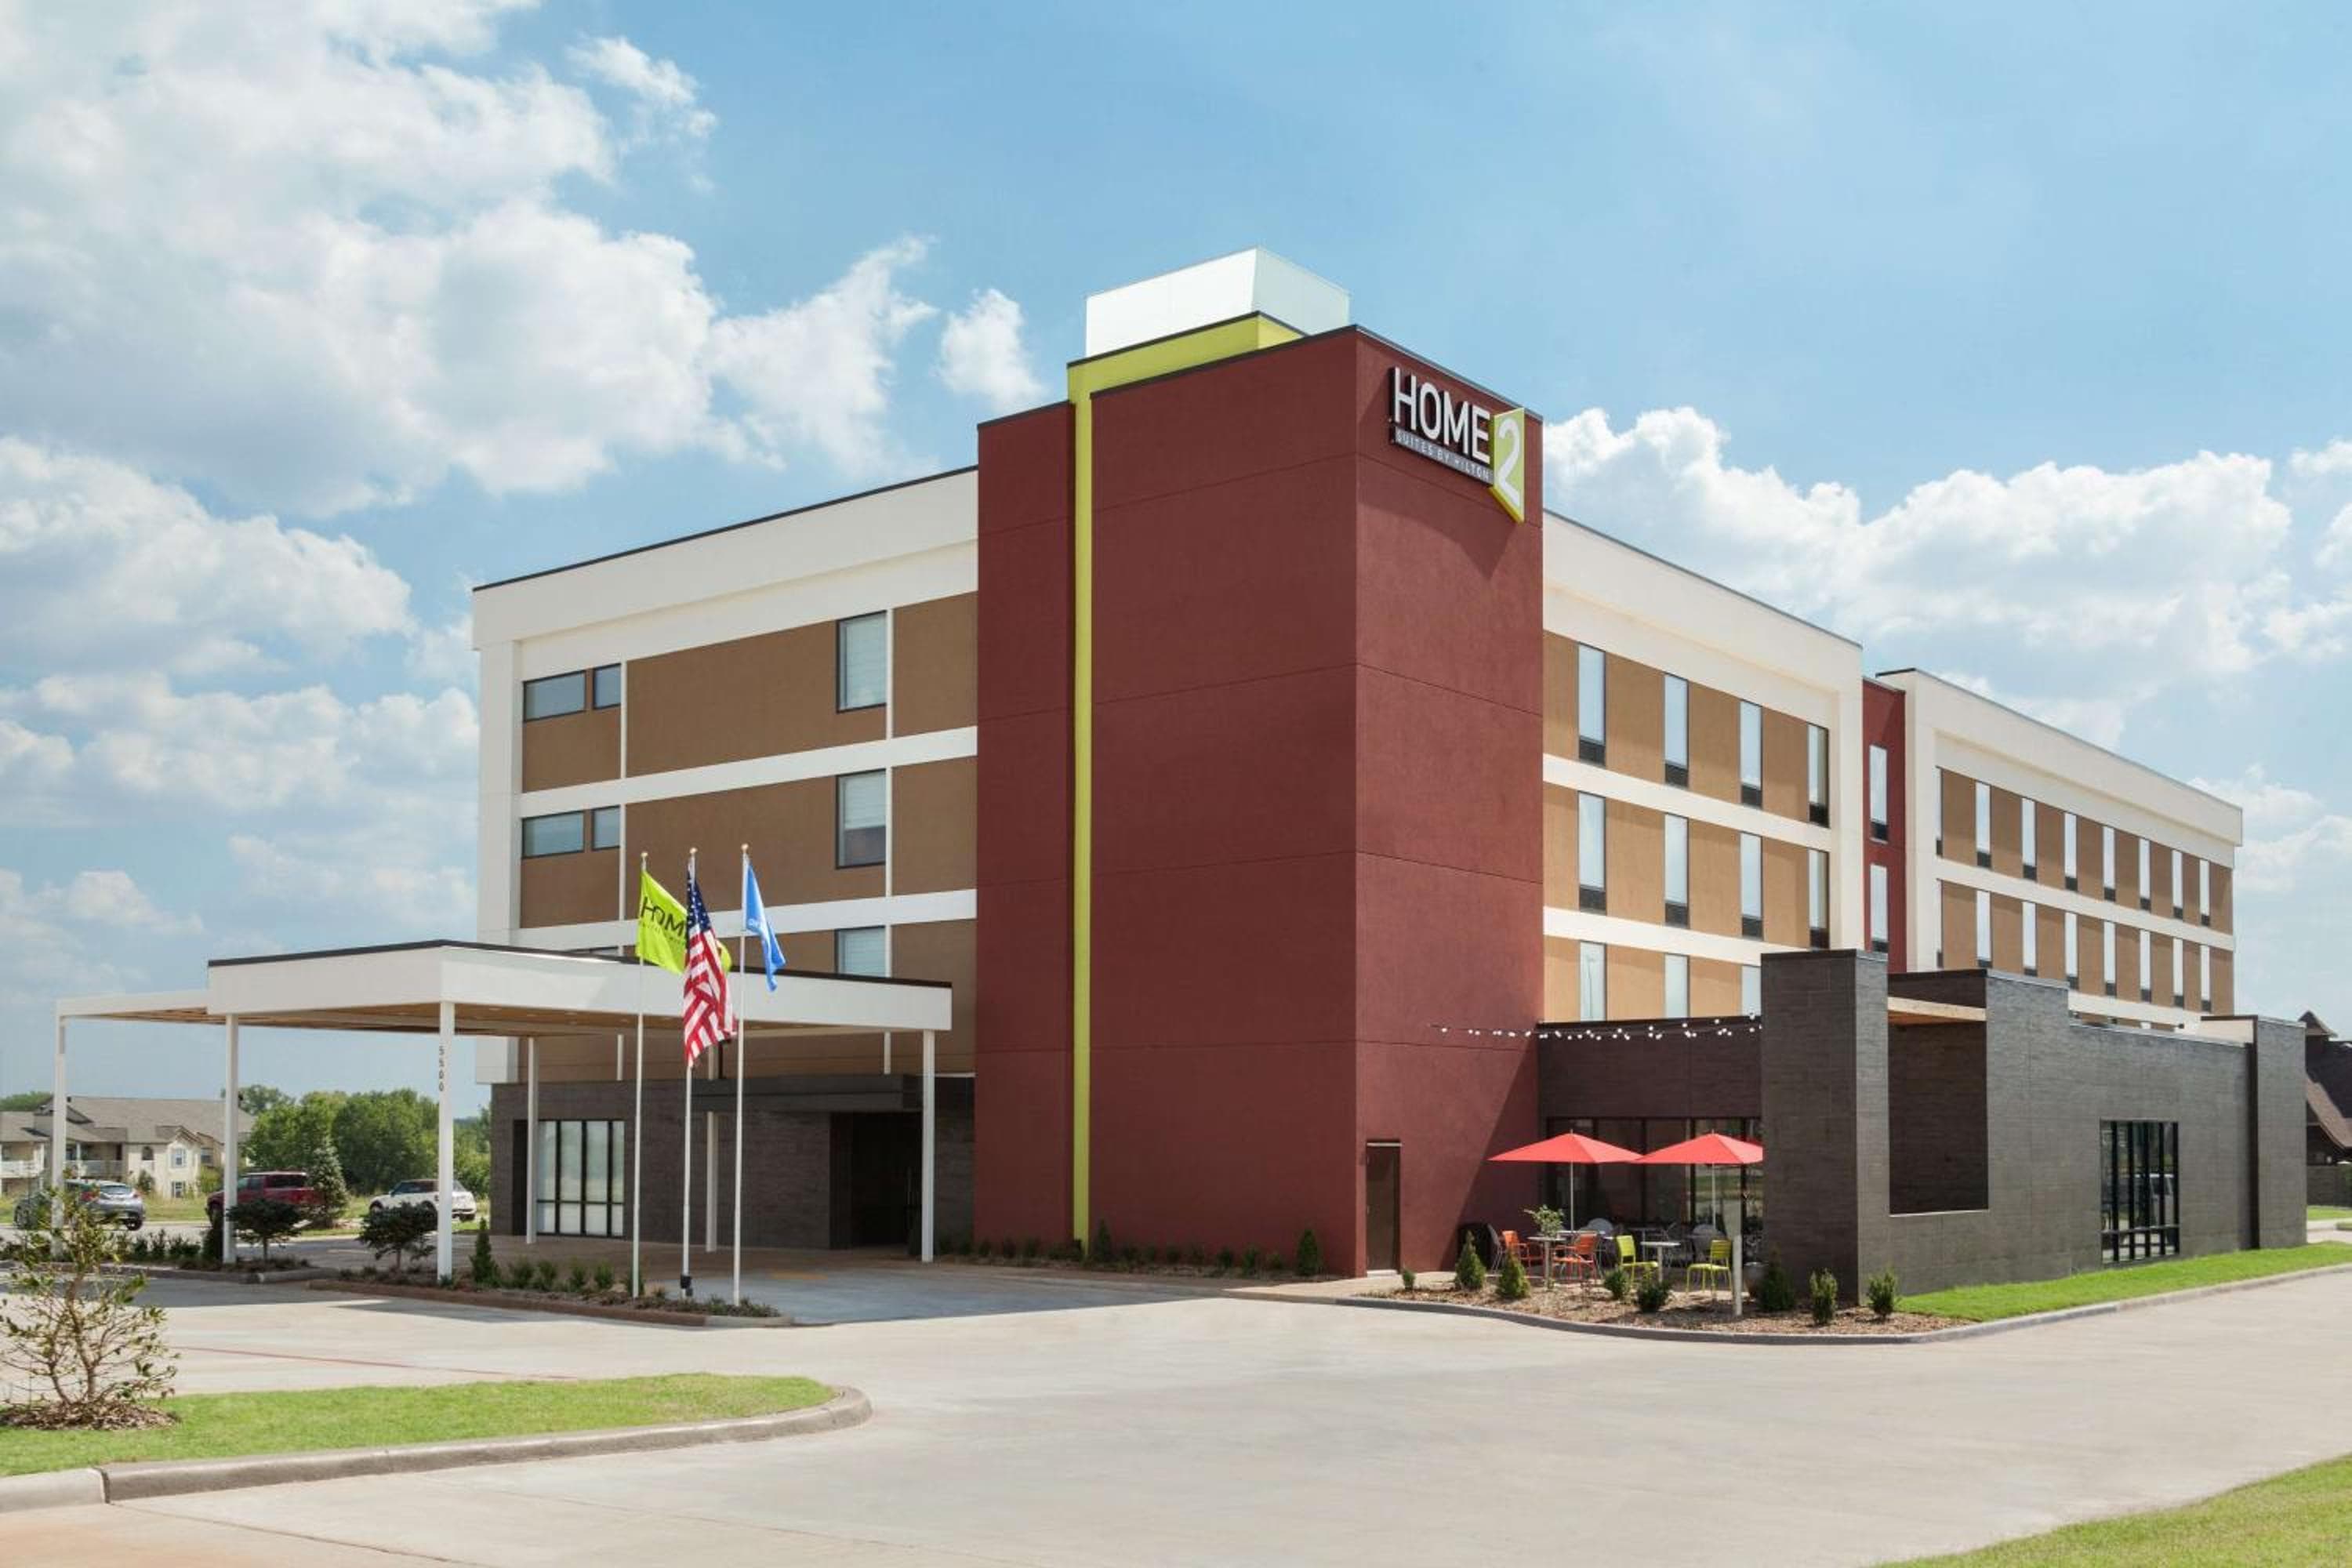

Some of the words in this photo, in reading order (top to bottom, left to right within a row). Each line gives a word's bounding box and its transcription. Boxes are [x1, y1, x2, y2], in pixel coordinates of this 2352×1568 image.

[1394, 366, 1490, 465] HOME
[1497, 417, 1521, 507] 2
[1396, 430, 1433, 457] SUITES
[1437, 448, 1450, 463] BY
[1454, 459, 1490, 481] HILTON
[641, 896, 685, 938] HOM
